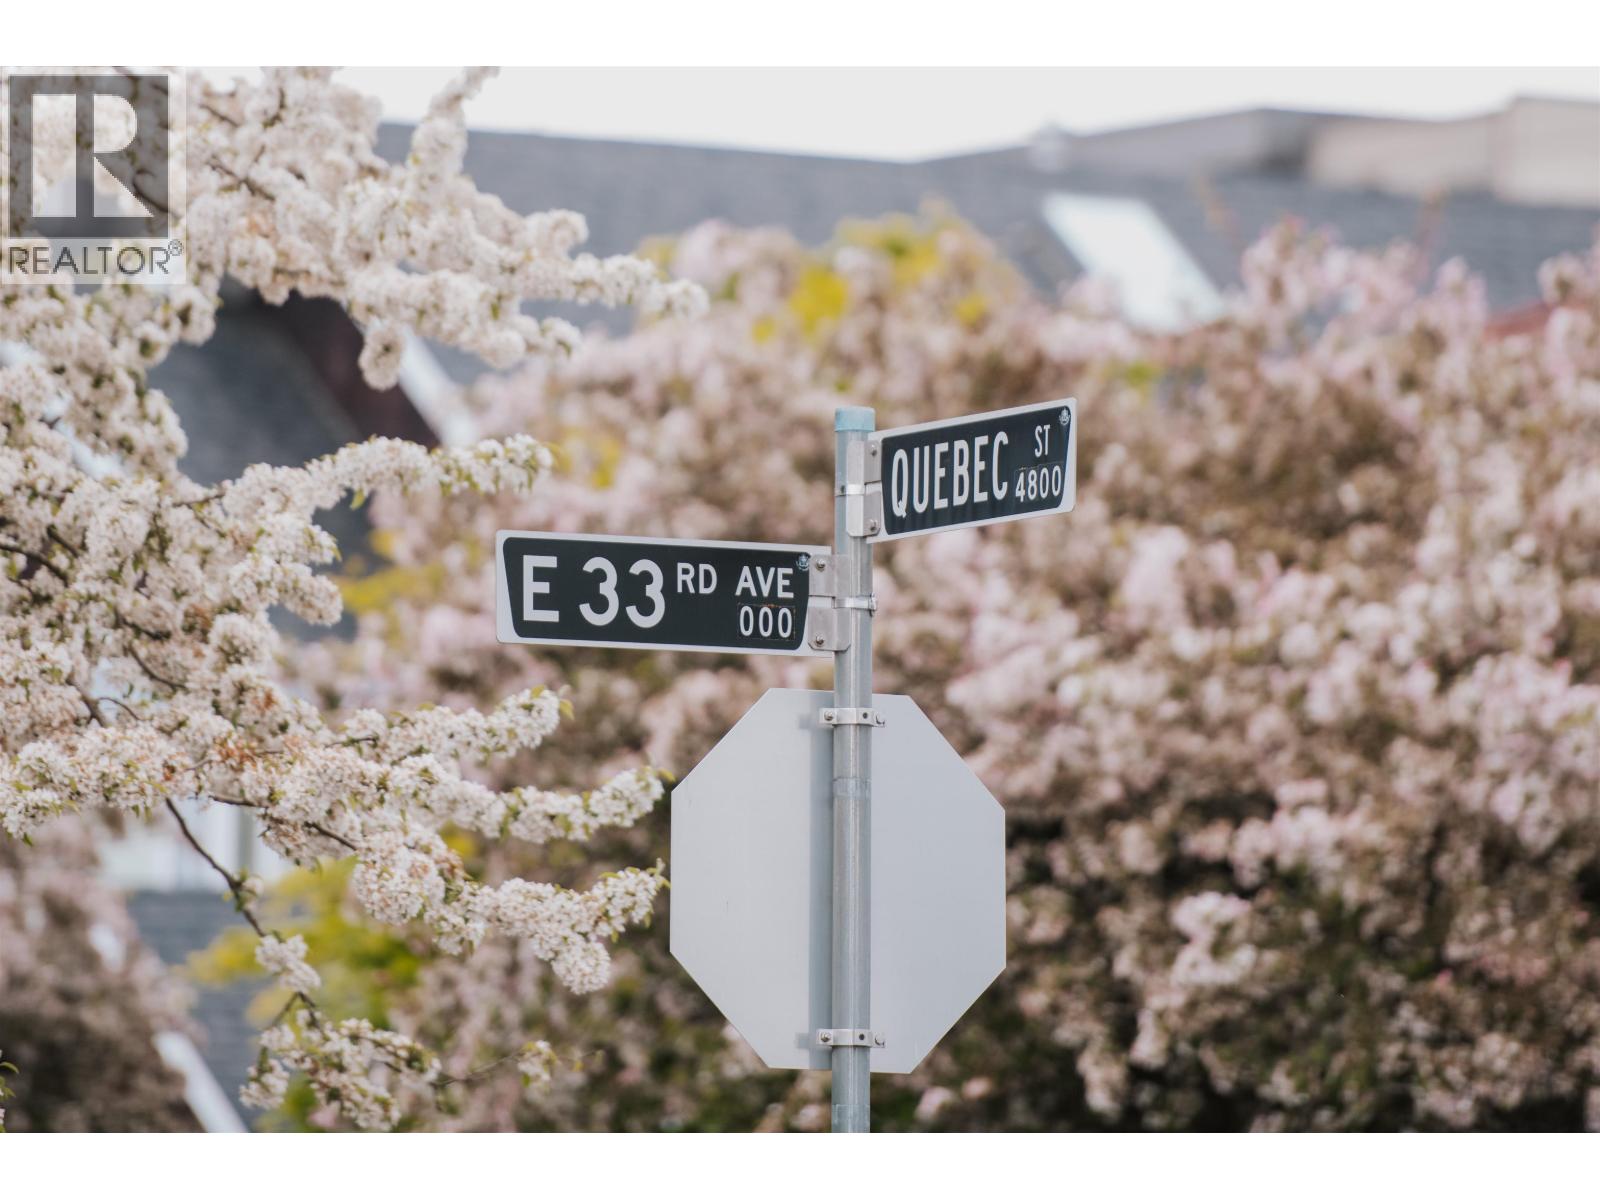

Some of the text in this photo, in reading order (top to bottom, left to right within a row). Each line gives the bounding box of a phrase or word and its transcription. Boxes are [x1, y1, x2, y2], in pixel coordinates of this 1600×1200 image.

[891, 424, 1051, 519] QUEBEC ST
[1015, 465, 1062, 503] 4800
[522, 554, 560, 622] E
[735, 566, 795, 599] AVE
[739, 605, 793, 639] 000
